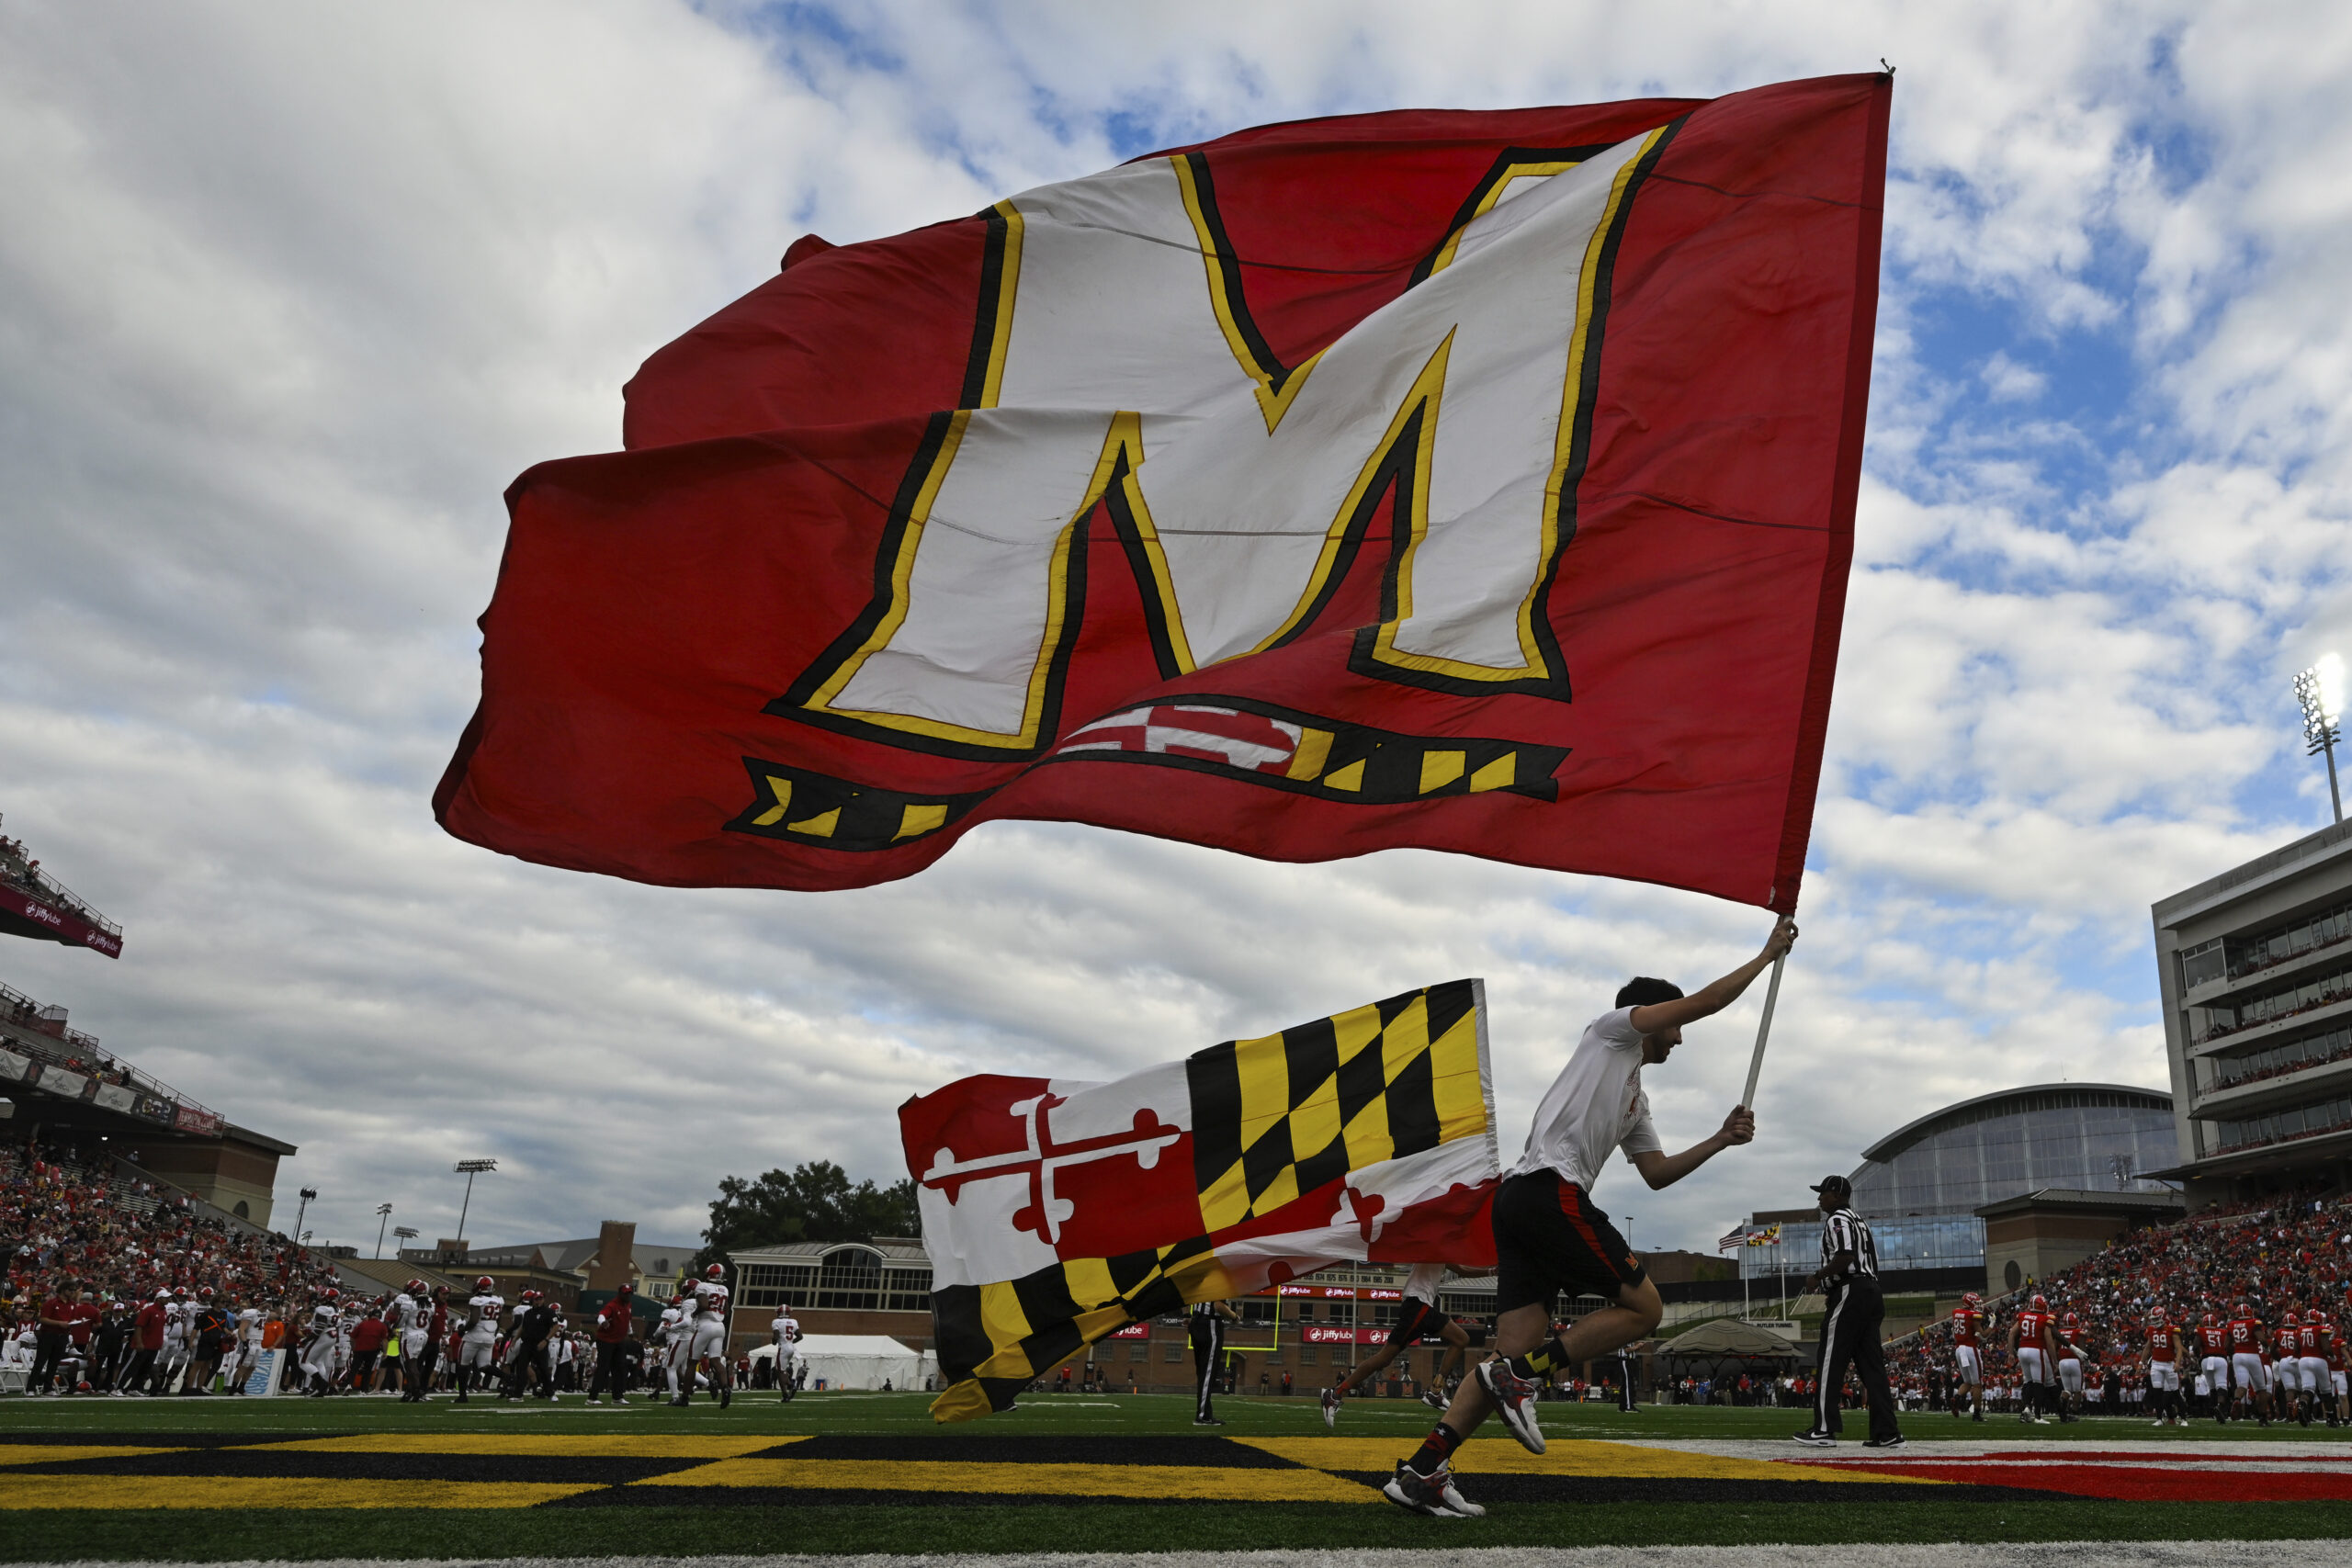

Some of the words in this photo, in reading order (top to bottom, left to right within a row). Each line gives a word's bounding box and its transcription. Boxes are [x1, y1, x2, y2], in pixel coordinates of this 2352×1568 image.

[708, 1292, 729, 1314] 20
[786, 1325, 794, 1340] 5
[2021, 1319, 2036, 1337] 91
[2233, 1328, 2249, 1343] 92
[2153, 1334, 2167, 1348] 99
[2207, 1335, 2222, 1348] 51
[2280, 1336, 2295, 1349] 46
[2301, 1332, 2314, 1347] 70
